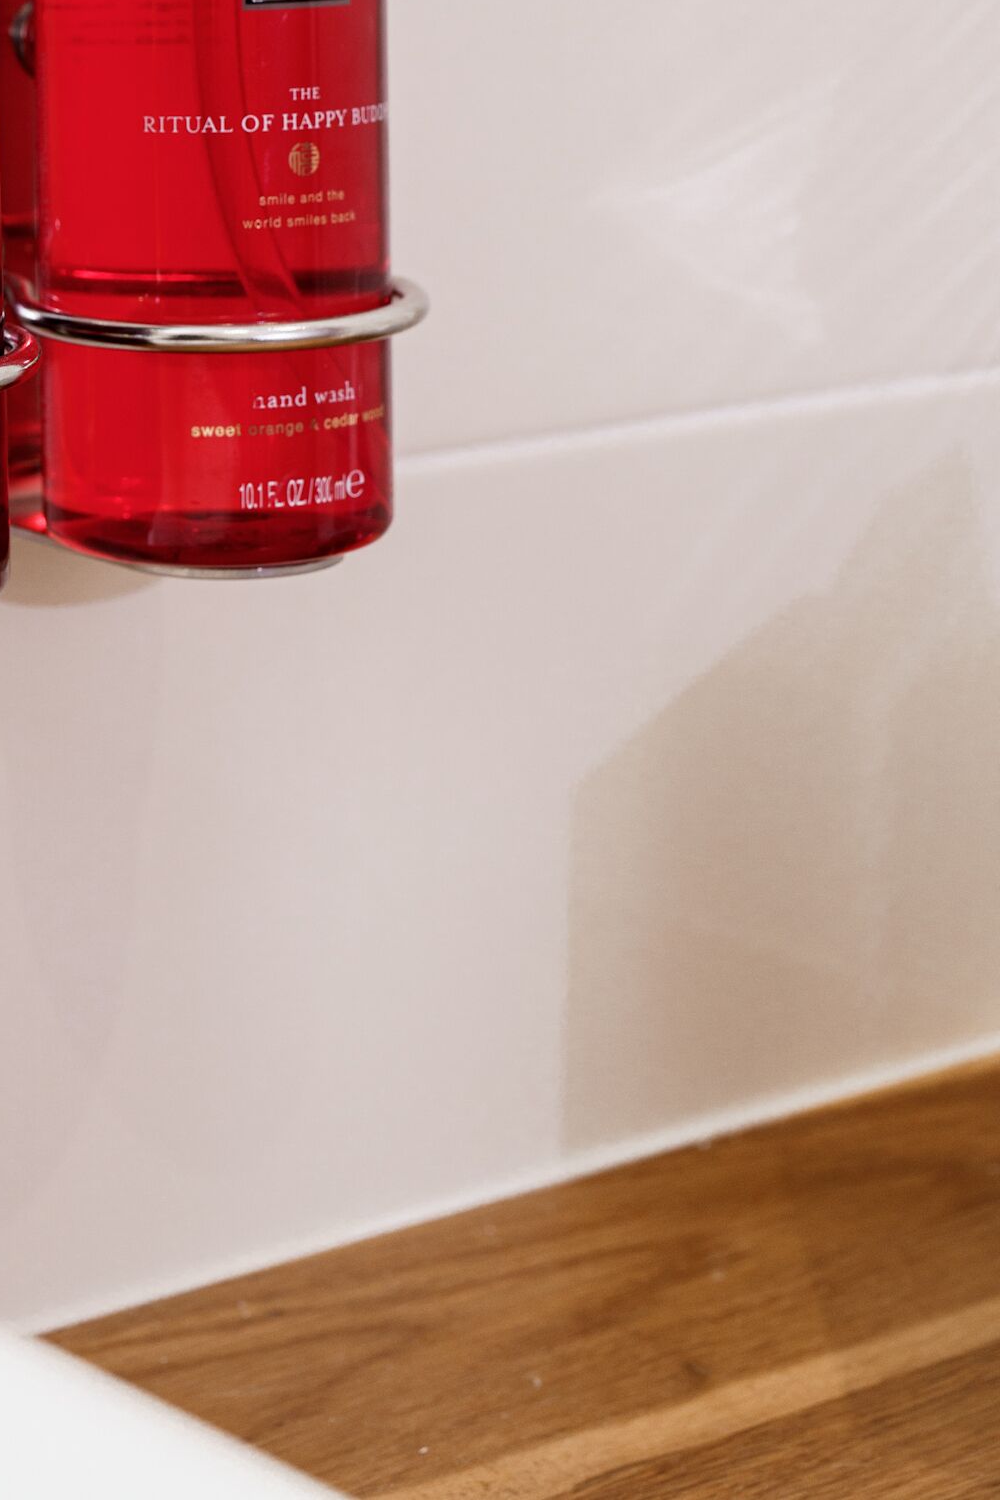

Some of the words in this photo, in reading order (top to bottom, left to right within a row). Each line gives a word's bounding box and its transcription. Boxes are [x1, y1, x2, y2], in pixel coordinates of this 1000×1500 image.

[289, 87, 321, 100] THE
[143, 116, 233, 133] RITUAL
[241, 114, 274, 132] OF
[282, 109, 347, 131] HAPPY
[259, 191, 295, 206] smile
[300, 189, 323, 203] and
[327, 189, 345, 201] the
[242, 218, 282, 229] world
[287, 215, 327, 228] smiles
[331, 210, 356, 224] back
[314, 380, 356, 404] wash
[191, 424, 241, 437] sweet
[248, 421, 304, 437] orange
[323, 411, 359, 430] cedar
[239, 482, 263, 510] 10.1
